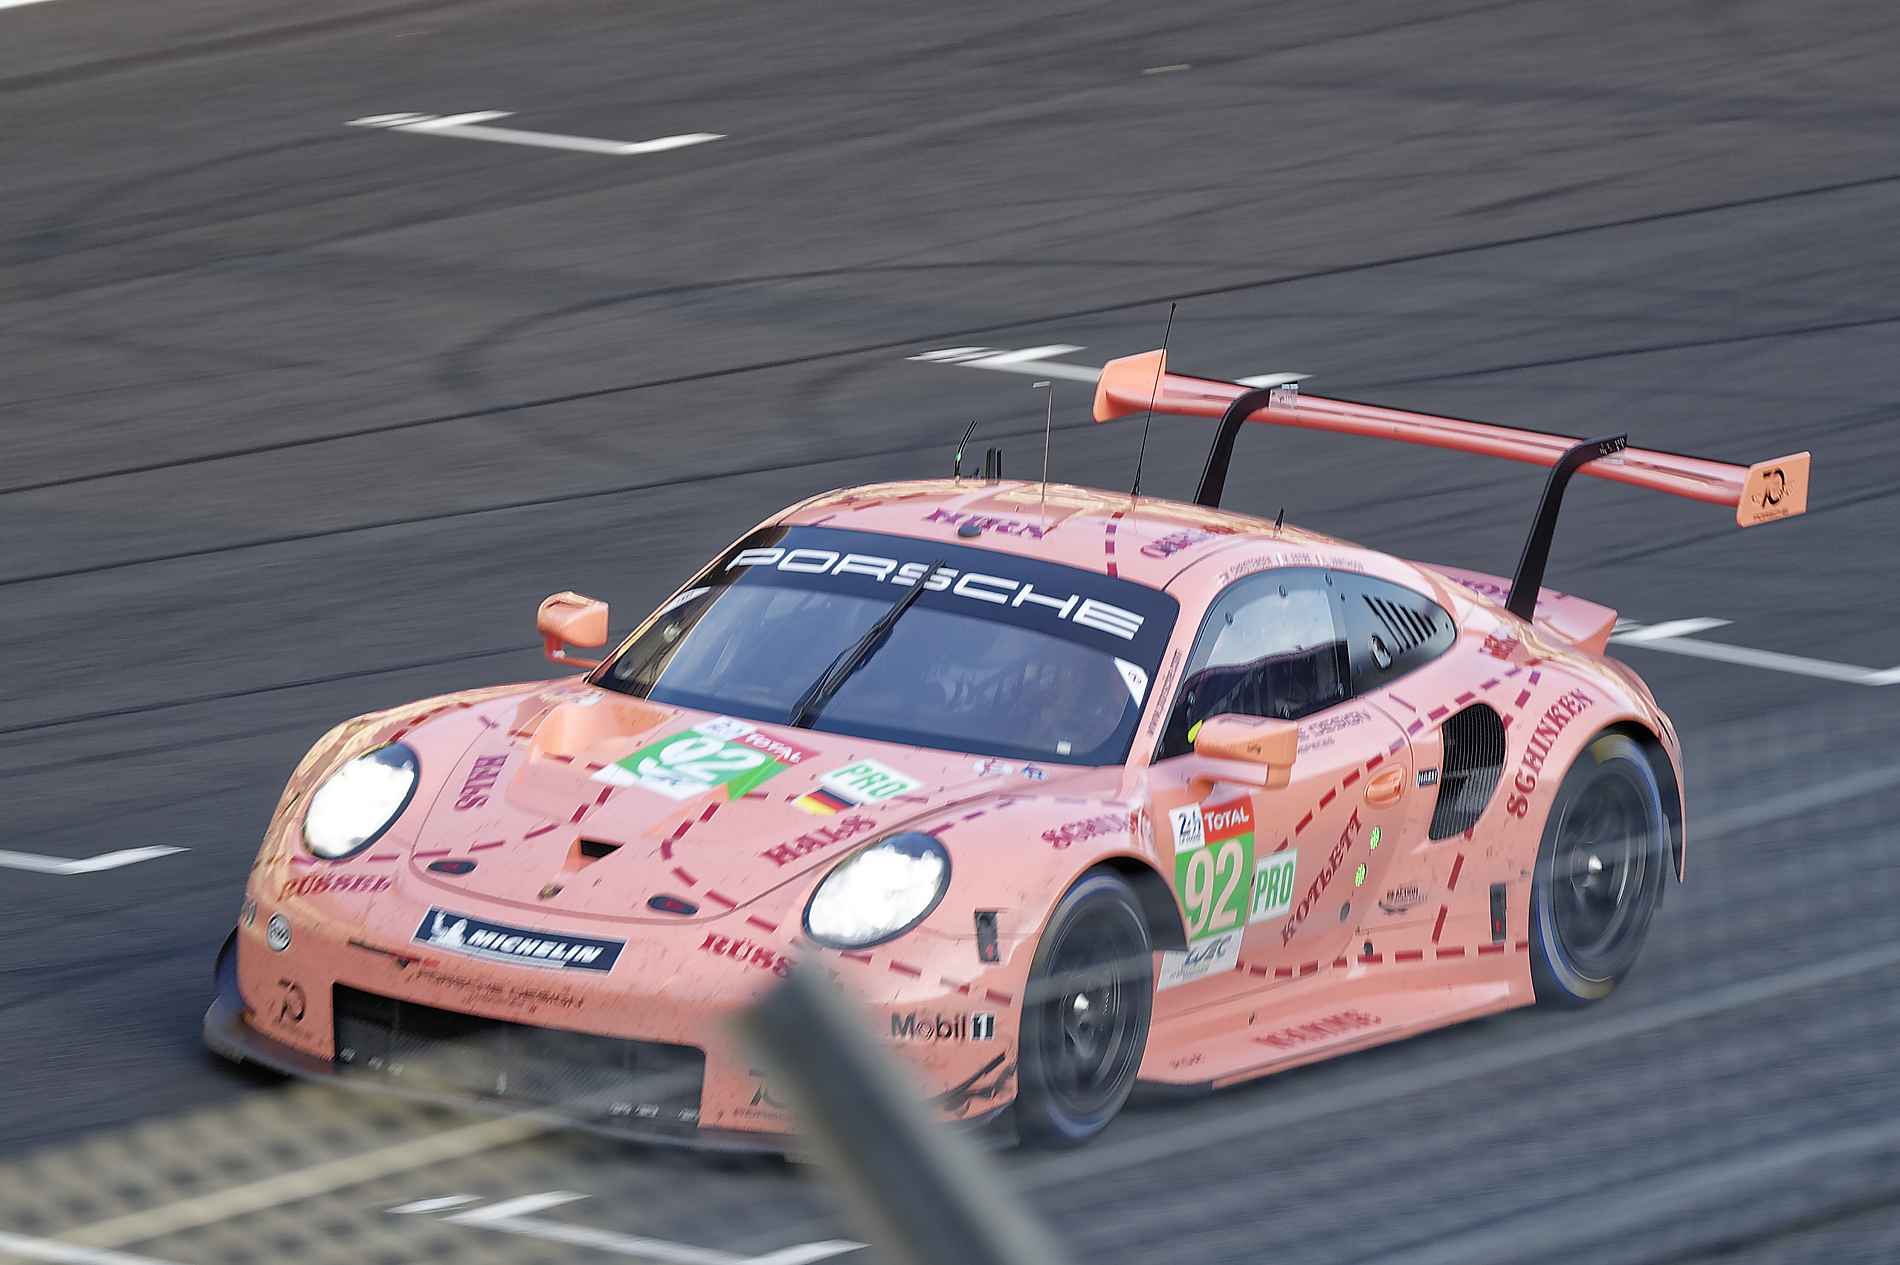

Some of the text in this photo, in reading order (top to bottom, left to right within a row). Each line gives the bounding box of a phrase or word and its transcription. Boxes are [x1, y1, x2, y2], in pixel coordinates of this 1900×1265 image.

[725, 547, 1145, 641] PORSCHE
[1506, 687, 1594, 819] SCHINKEN
[832, 763, 908, 797] PRO
[760, 814, 878, 866] HALS
[1205, 806, 1251, 832] TOTAL
[1185, 839, 1244, 938] 92
[1253, 860, 1294, 915] PRO
[468, 929, 604, 963] MICHELIN
[891, 1013, 995, 1040] Mobil 1
